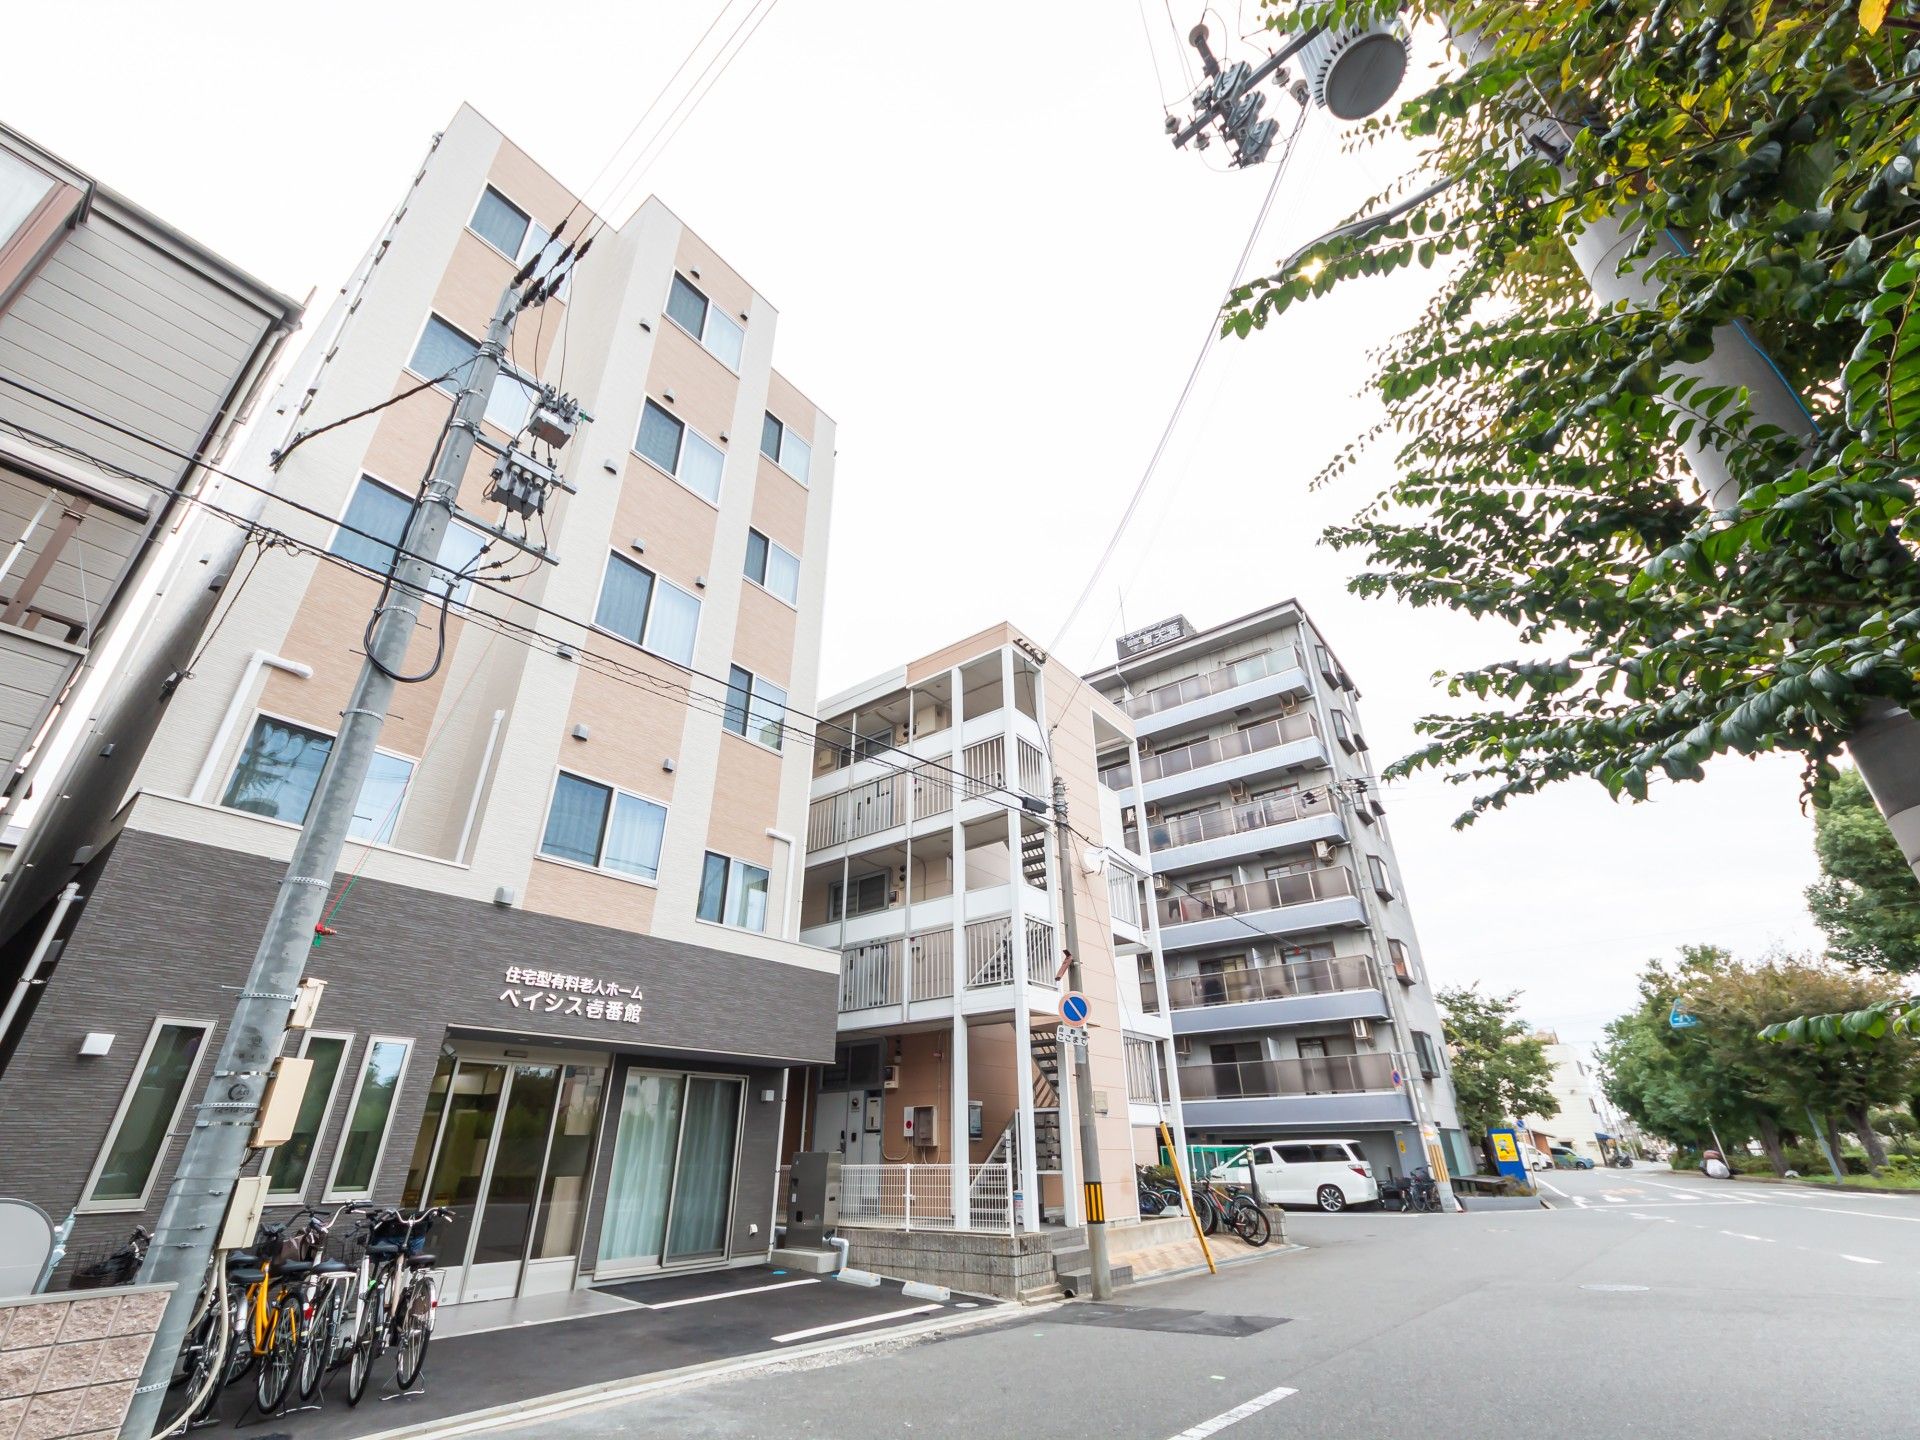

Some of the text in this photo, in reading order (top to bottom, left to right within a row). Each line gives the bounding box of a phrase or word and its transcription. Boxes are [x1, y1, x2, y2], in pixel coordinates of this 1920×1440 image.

[505, 966, 643, 1000] 住宅型有料老人ホーム
[499, 989, 642, 1023] ベイシス壱番館
[1058, 1033, 1087, 1045] ここまで
